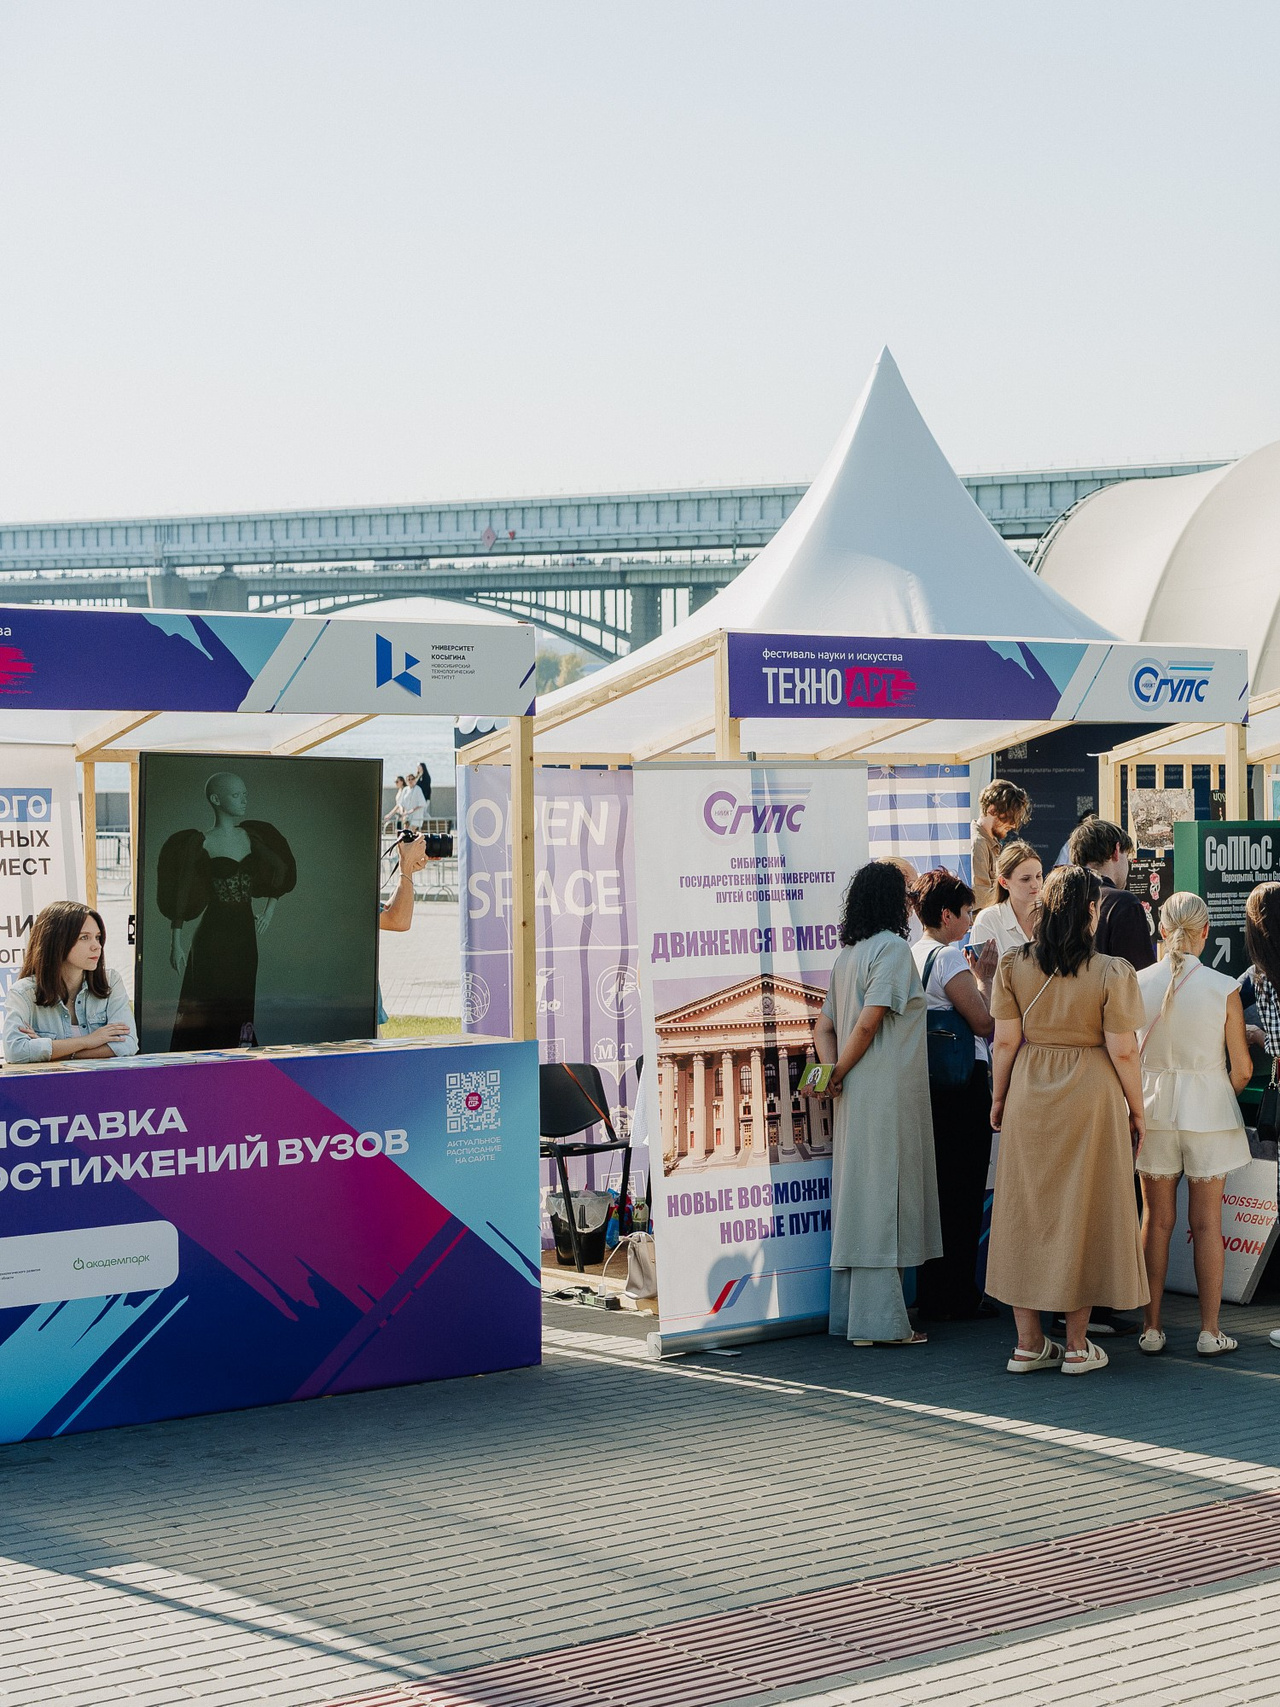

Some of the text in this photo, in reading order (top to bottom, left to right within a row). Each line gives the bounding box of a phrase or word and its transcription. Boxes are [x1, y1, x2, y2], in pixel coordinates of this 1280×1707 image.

[762, 648, 903, 663] фестиваль науки и искусства
[762, 667, 896, 705] ТЕХНО АРТ
[1134, 666, 1210, 703] СГУПС
[703, 791, 806, 836] СГУПС
[730, 854, 786, 869] СИБИРСКИЙ
[1205, 835, 1273, 872] СоППоС
[775, 871, 836, 886] УНИВЕРСИТЕТ
[716, 888, 804, 903] ПУТЕЙ СООБЩЕНИЯ
[651, 928, 777, 963] ДВИЖЕМСЯ
[278, 1129, 409, 1166] ВУЗОВ
[447, 1136, 501, 1148] АКТУАЛЬНОЕ
[447, 1145, 502, 1156] РАСПИСАНИЕ
[468, 1153, 495, 1163] САЙТЕ
[667, 1177, 832, 1217] НОВЫЕ ВОЗМОЖН
[720, 1215, 785, 1244] НОВЫЕ
[86, 1254, 150, 1269] академпарк
